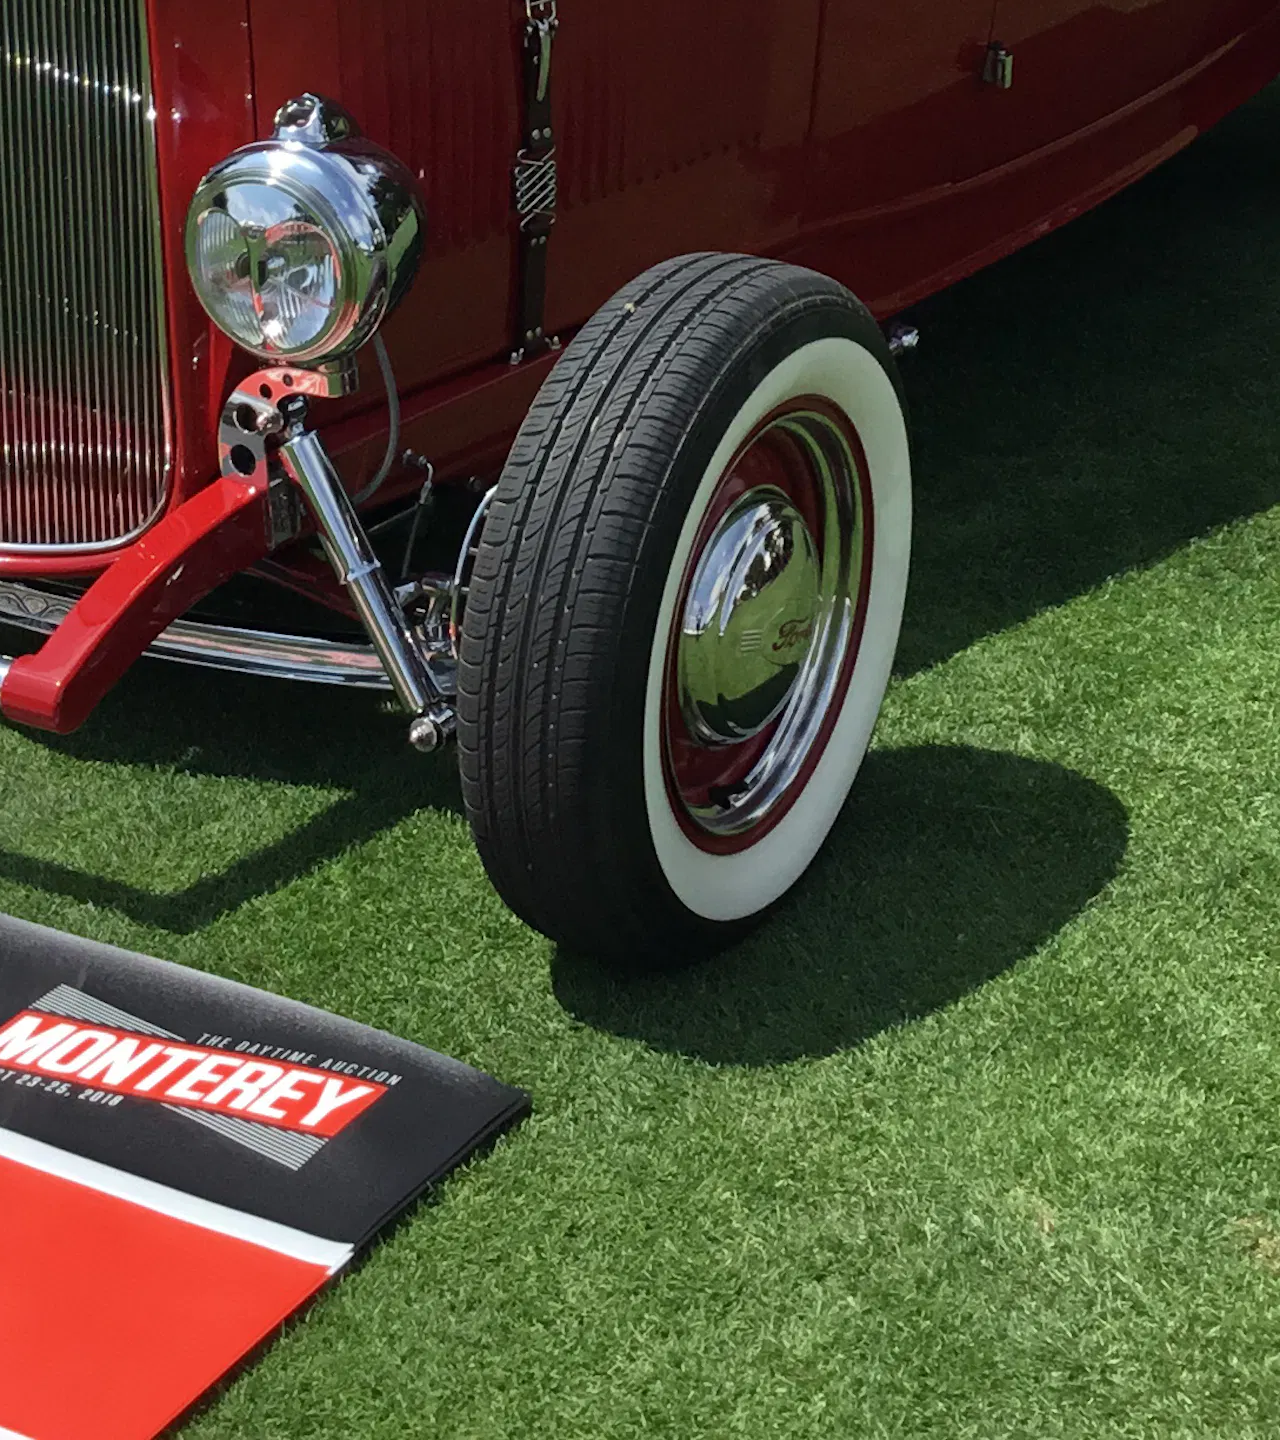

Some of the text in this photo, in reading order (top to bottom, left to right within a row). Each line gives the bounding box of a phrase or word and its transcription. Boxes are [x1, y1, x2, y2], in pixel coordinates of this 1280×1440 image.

[196, 1033, 403, 1086] THE DAYTIME AUCTION
[16, 1073, 71, 1097] 23-25,
[78, 1087, 124, 1106] 2018
